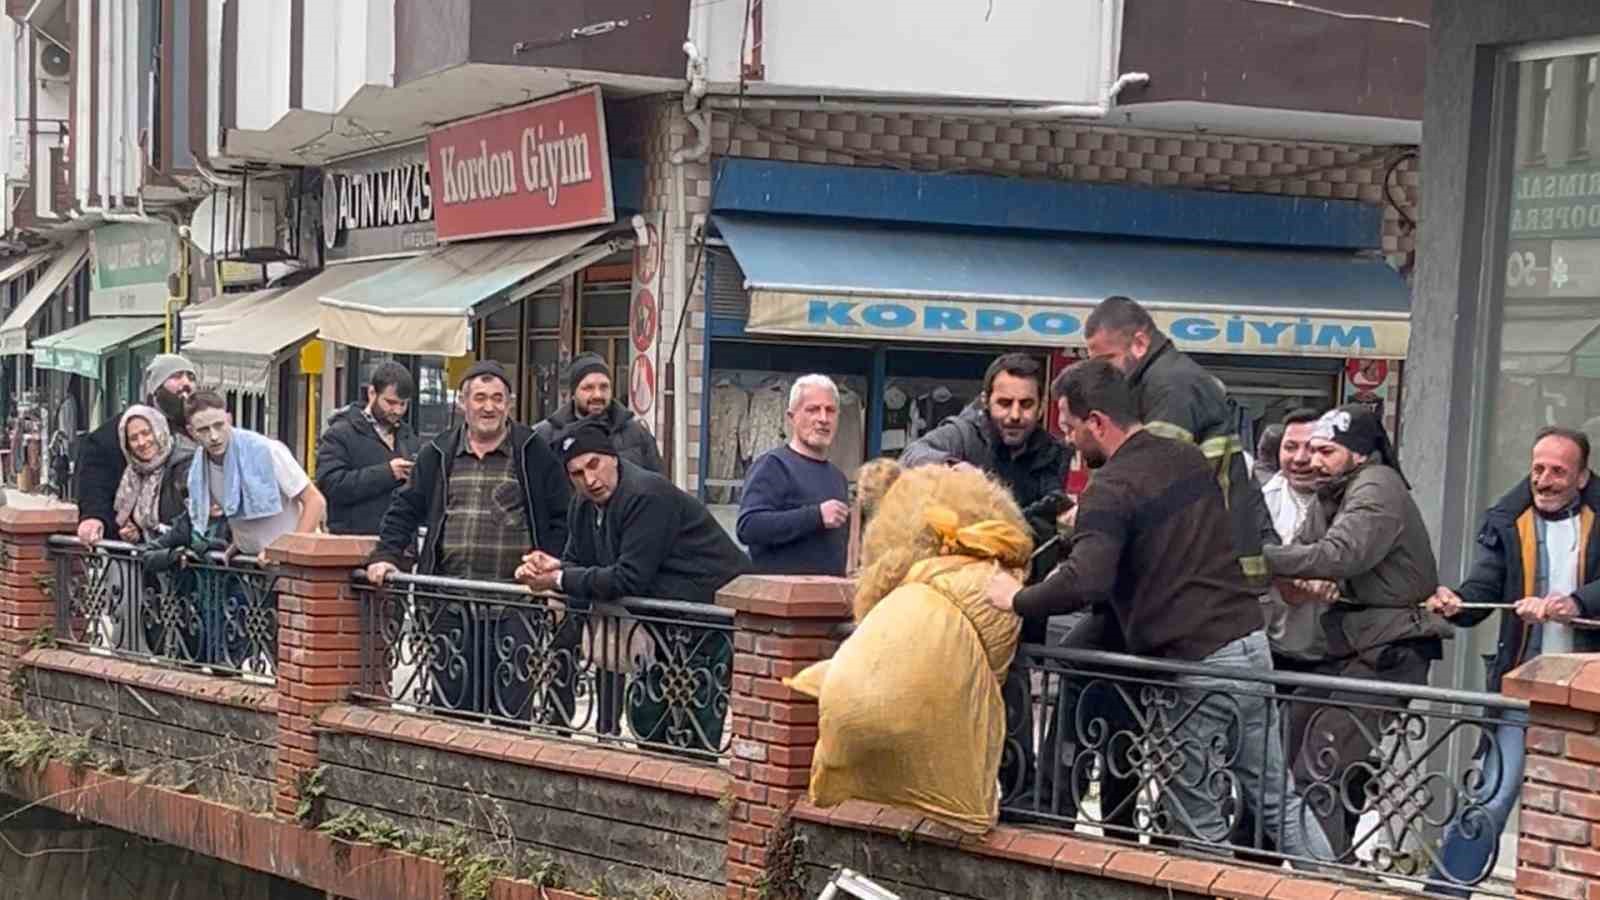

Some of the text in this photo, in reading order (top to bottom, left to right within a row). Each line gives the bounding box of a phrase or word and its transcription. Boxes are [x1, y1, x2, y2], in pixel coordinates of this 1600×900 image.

[378, 161, 432, 226] MAKAS
[440, 119, 592, 206] Kordon Giyim
[807, 300, 1377, 349] KORDO GİYİM
